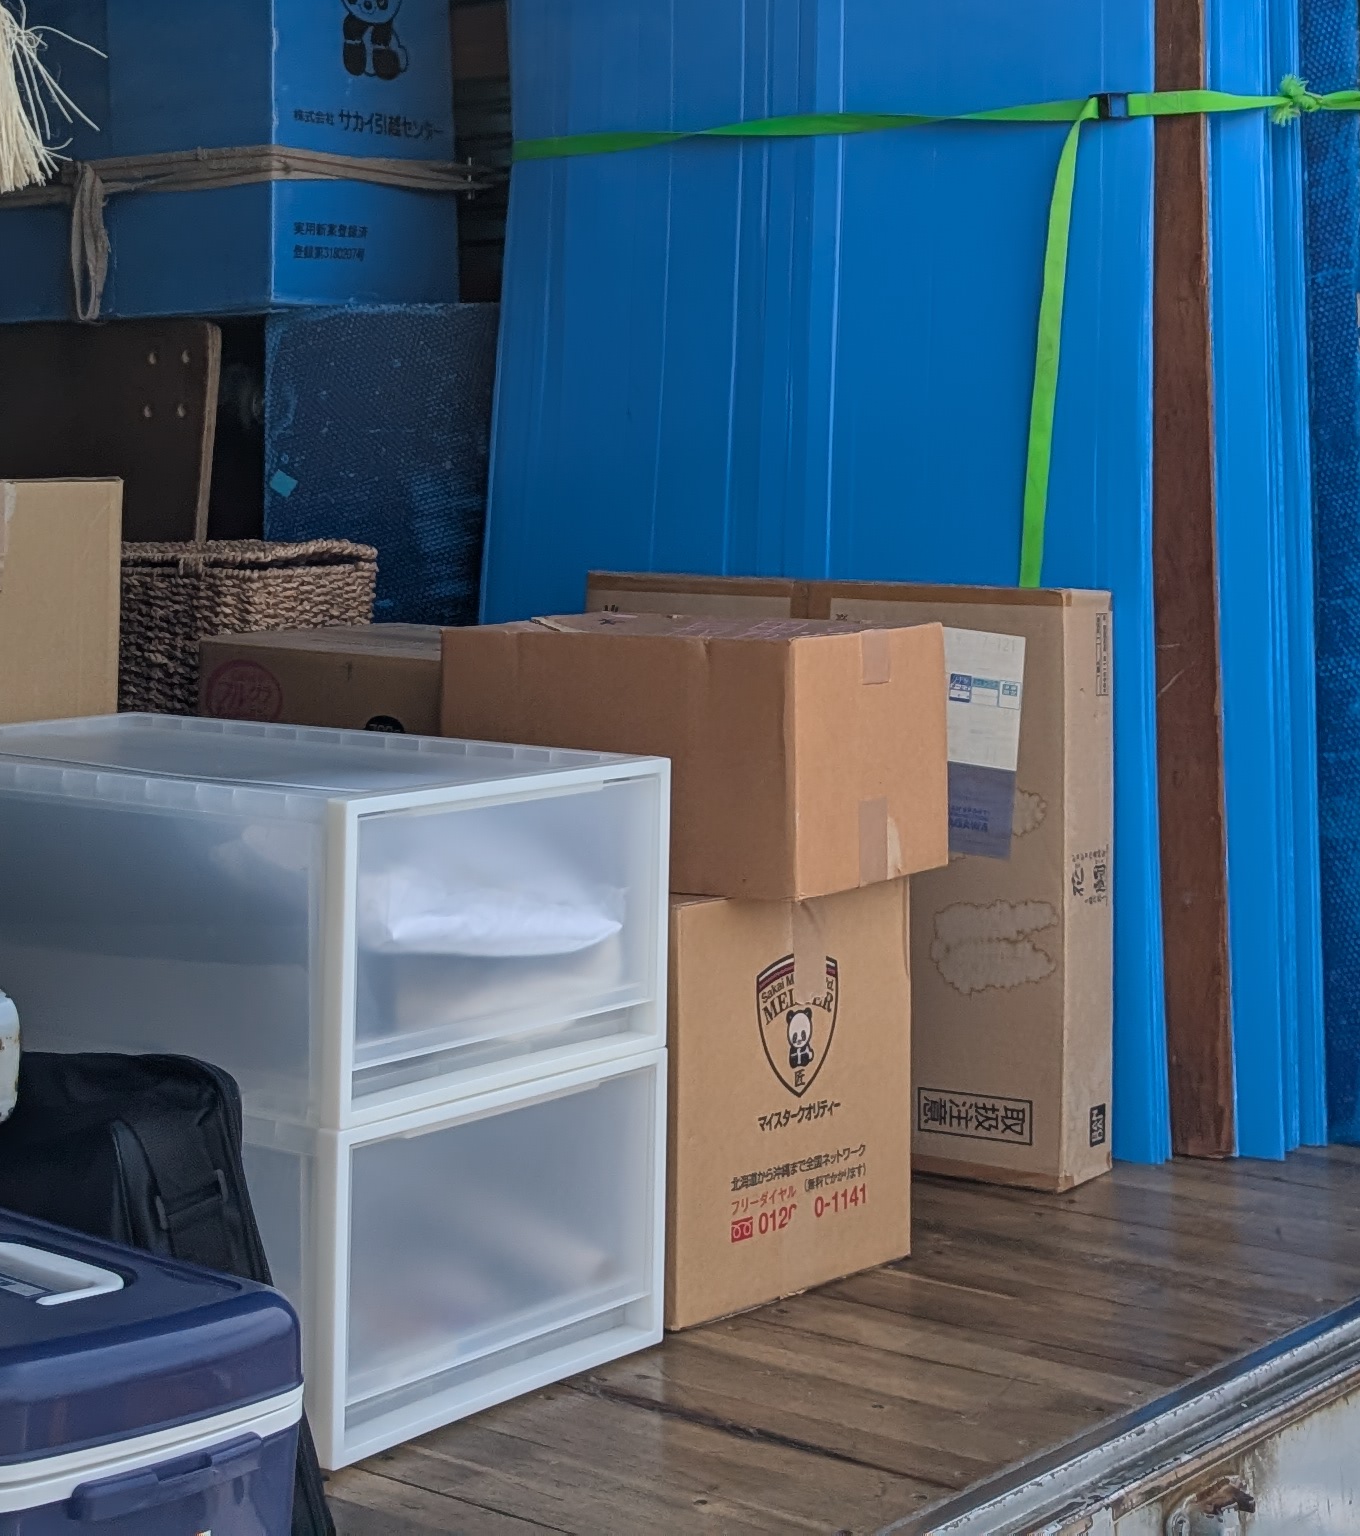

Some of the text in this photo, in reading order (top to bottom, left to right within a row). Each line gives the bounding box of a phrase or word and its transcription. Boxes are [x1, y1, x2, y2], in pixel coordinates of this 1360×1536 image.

[338, 109, 445, 141] サカイ引越センター
[761, 977, 785, 1004] Sakai
[761, 988, 834, 1026] MEIER
[758, 1100, 841, 1132] マイスタークオリティー
[923, 1095, 1026, 1137] 取扱注意
[731, 1186, 797, 1216] フリーダイヤル
